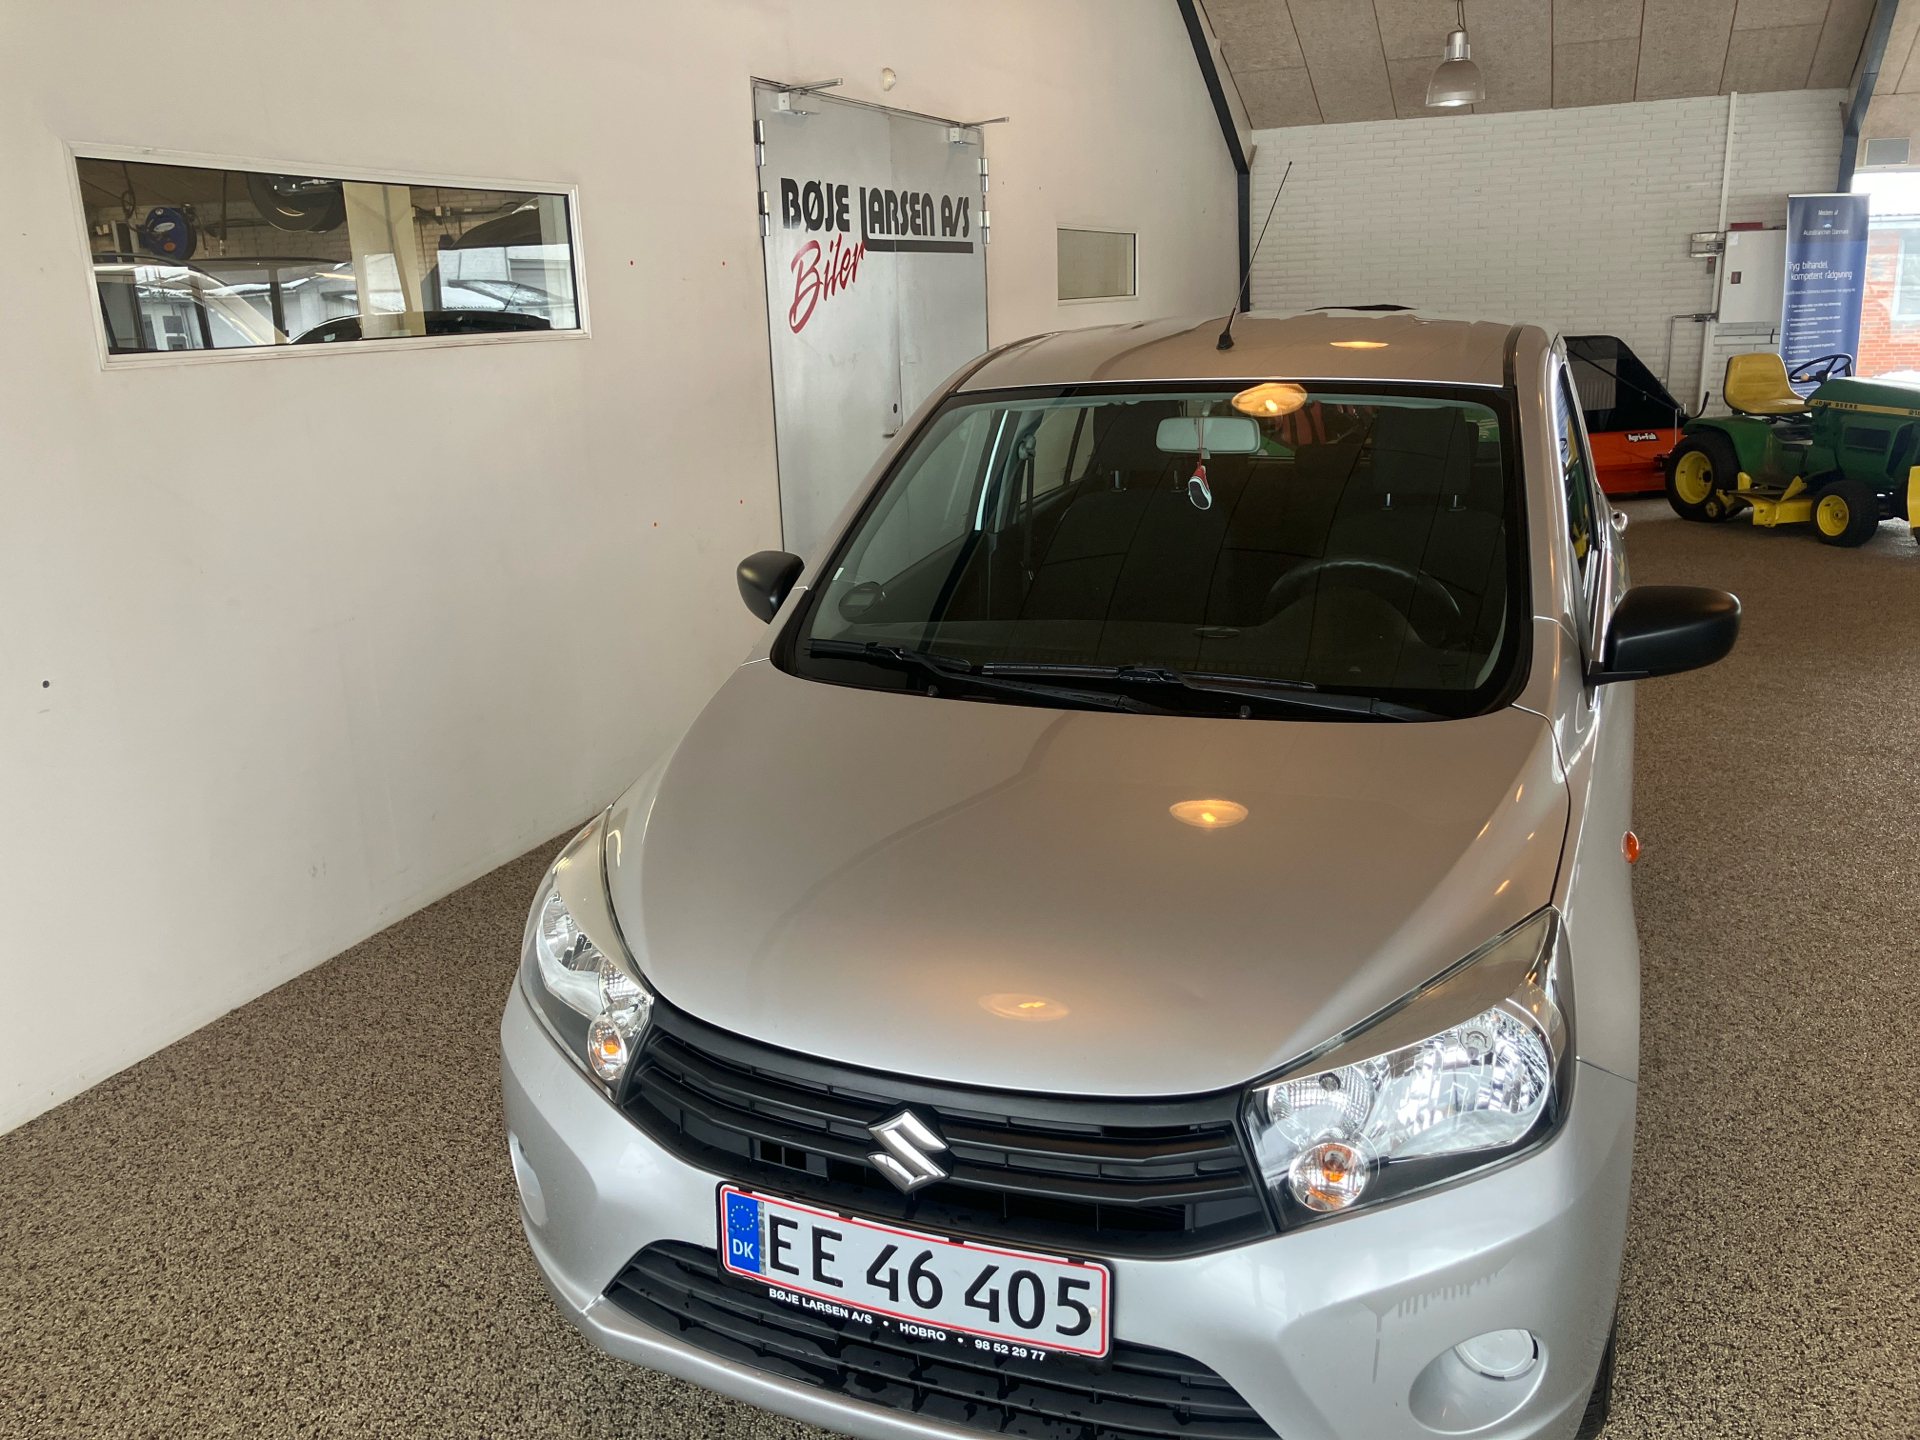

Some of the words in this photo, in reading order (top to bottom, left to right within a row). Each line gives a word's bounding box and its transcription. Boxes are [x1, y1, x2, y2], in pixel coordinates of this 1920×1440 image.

[780, 177, 850, 233] BØJE
[859, 187, 936, 246] LARSEN
[940, 194, 970, 238] A/S
[788, 232, 866, 334] Biler
[1788, 261, 1800, 272] Tryg
[1791, 271, 1823, 281] kompetent
[1824, 270, 1853, 280] rådgivning
[1835, 402, 1858, 410] DEERE
[732, 1238, 755, 1260] DK
[769, 1213, 844, 1288] EE
[866, 1243, 943, 1310] 46
[964, 1263, 1092, 1337] 405
[769, 1288, 800, 1305] BØJE
[802, 1297, 849, 1319] LARSEN
[851, 1310, 873, 1325] A/S
[899, 1322, 947, 1342] HOBRO
[974, 1338, 991, 1350] 98
[993, 1343, 1009, 1355] 52
[1011, 1347, 1028, 1358] 29
[1030, 1350, 1046, 1362] 77
